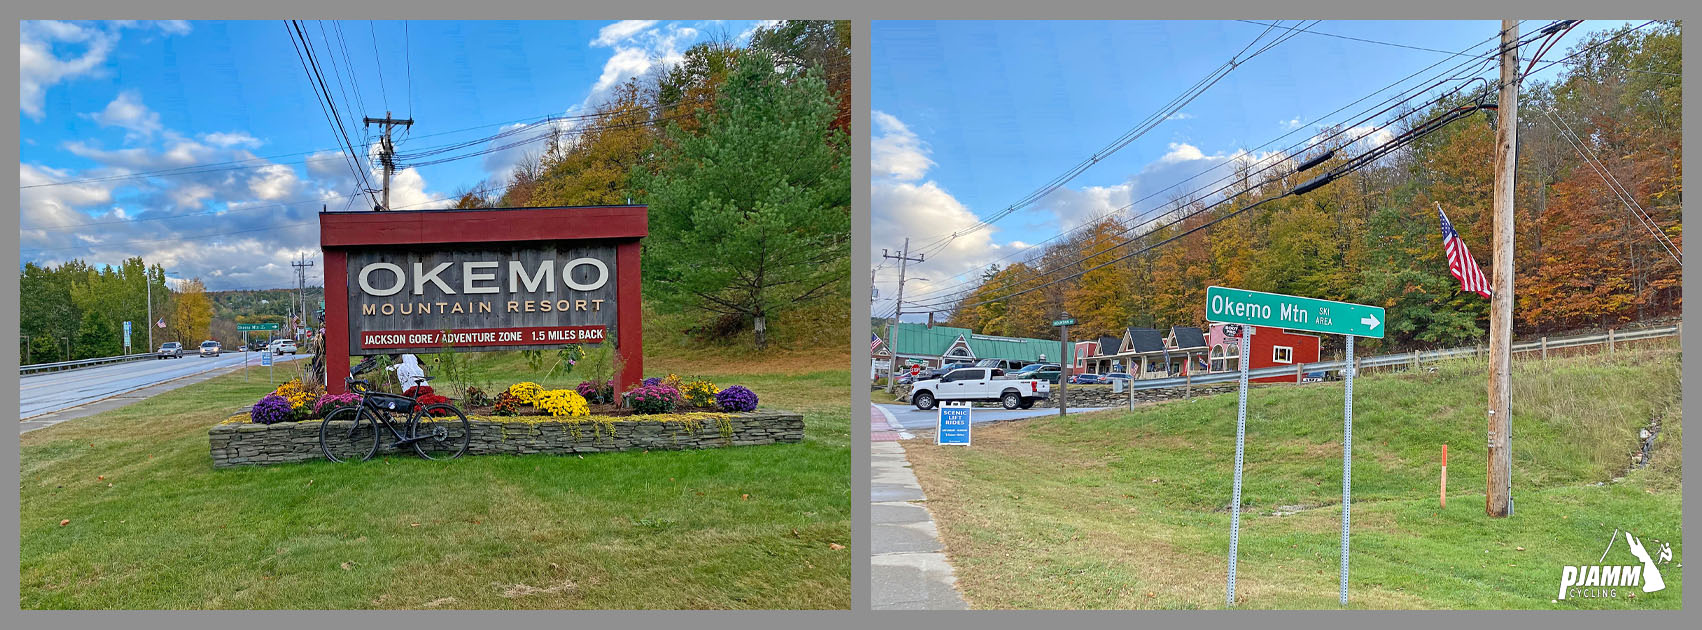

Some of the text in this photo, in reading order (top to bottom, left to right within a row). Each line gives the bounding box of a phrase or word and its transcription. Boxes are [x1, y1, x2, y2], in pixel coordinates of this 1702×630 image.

[358, 257, 609, 296] OKEMO
[362, 299, 604, 316] MOUNTAIN RESORT
[1211, 294, 1308, 324] Okemo Mtn
[1319, 307, 1330, 316] SKI
[1315, 317, 1333, 326] AREA
[364, 333, 406, 345] JACKSON
[408, 333, 433, 344] GORE
[441, 332, 496, 344] ADVENTURE
[498, 331, 523, 342] ZONE
[531, 330, 545, 341] 1.5
[547, 329, 576, 341] MILES
[578, 328, 603, 340] BACK
